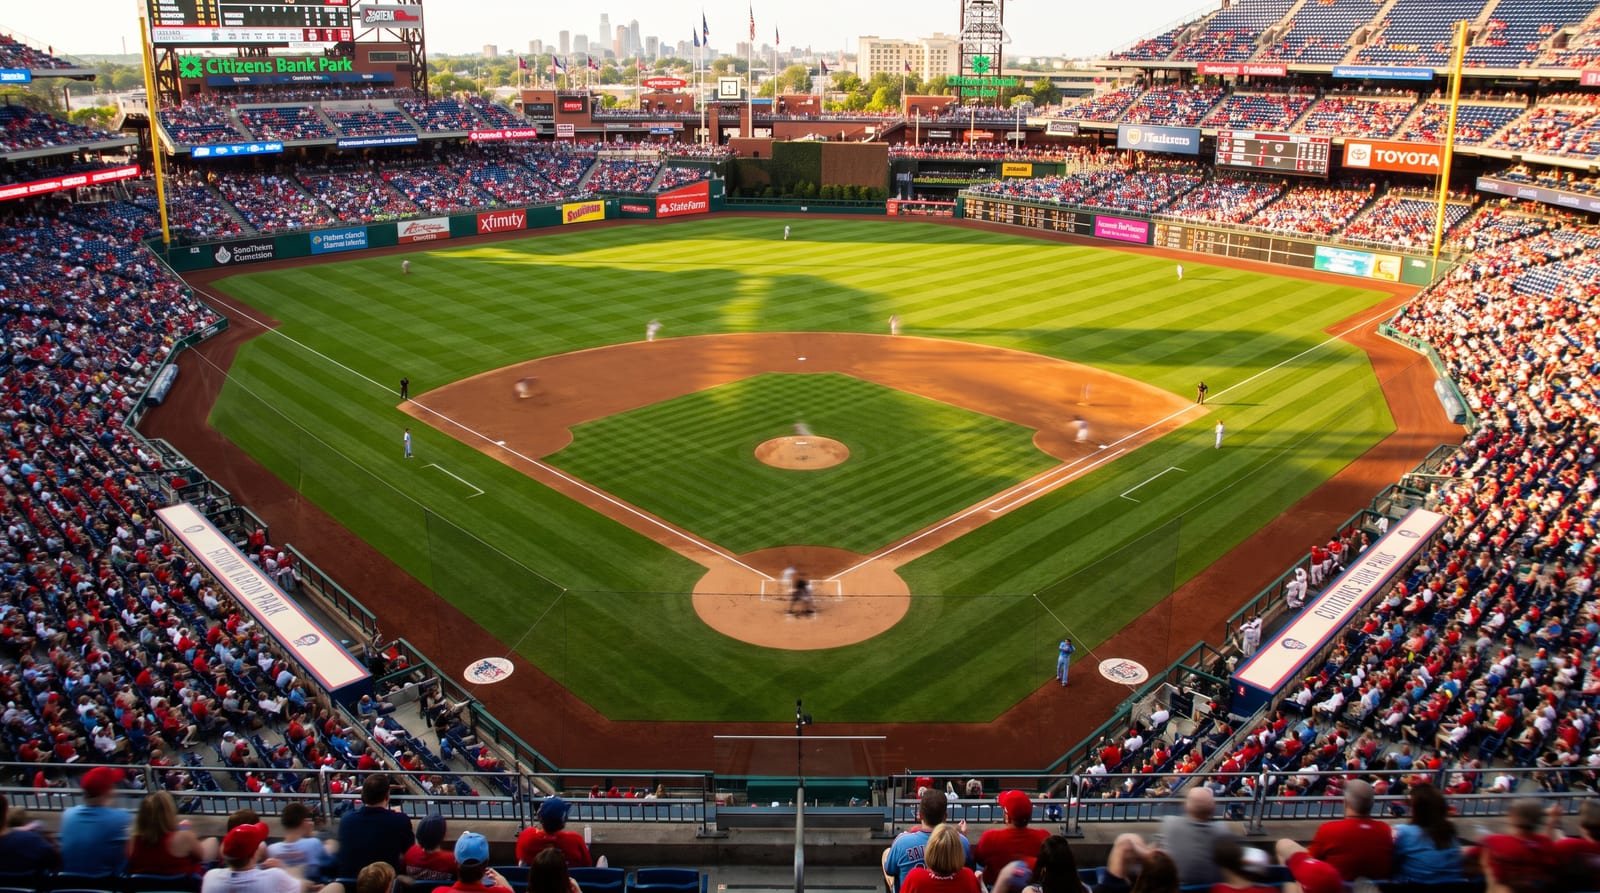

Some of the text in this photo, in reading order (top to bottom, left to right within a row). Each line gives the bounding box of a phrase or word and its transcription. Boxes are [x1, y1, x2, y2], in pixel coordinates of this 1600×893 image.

[206, 56, 353, 74] Citizens Bank Park
[1375, 149, 1440, 167] TOYOTA
